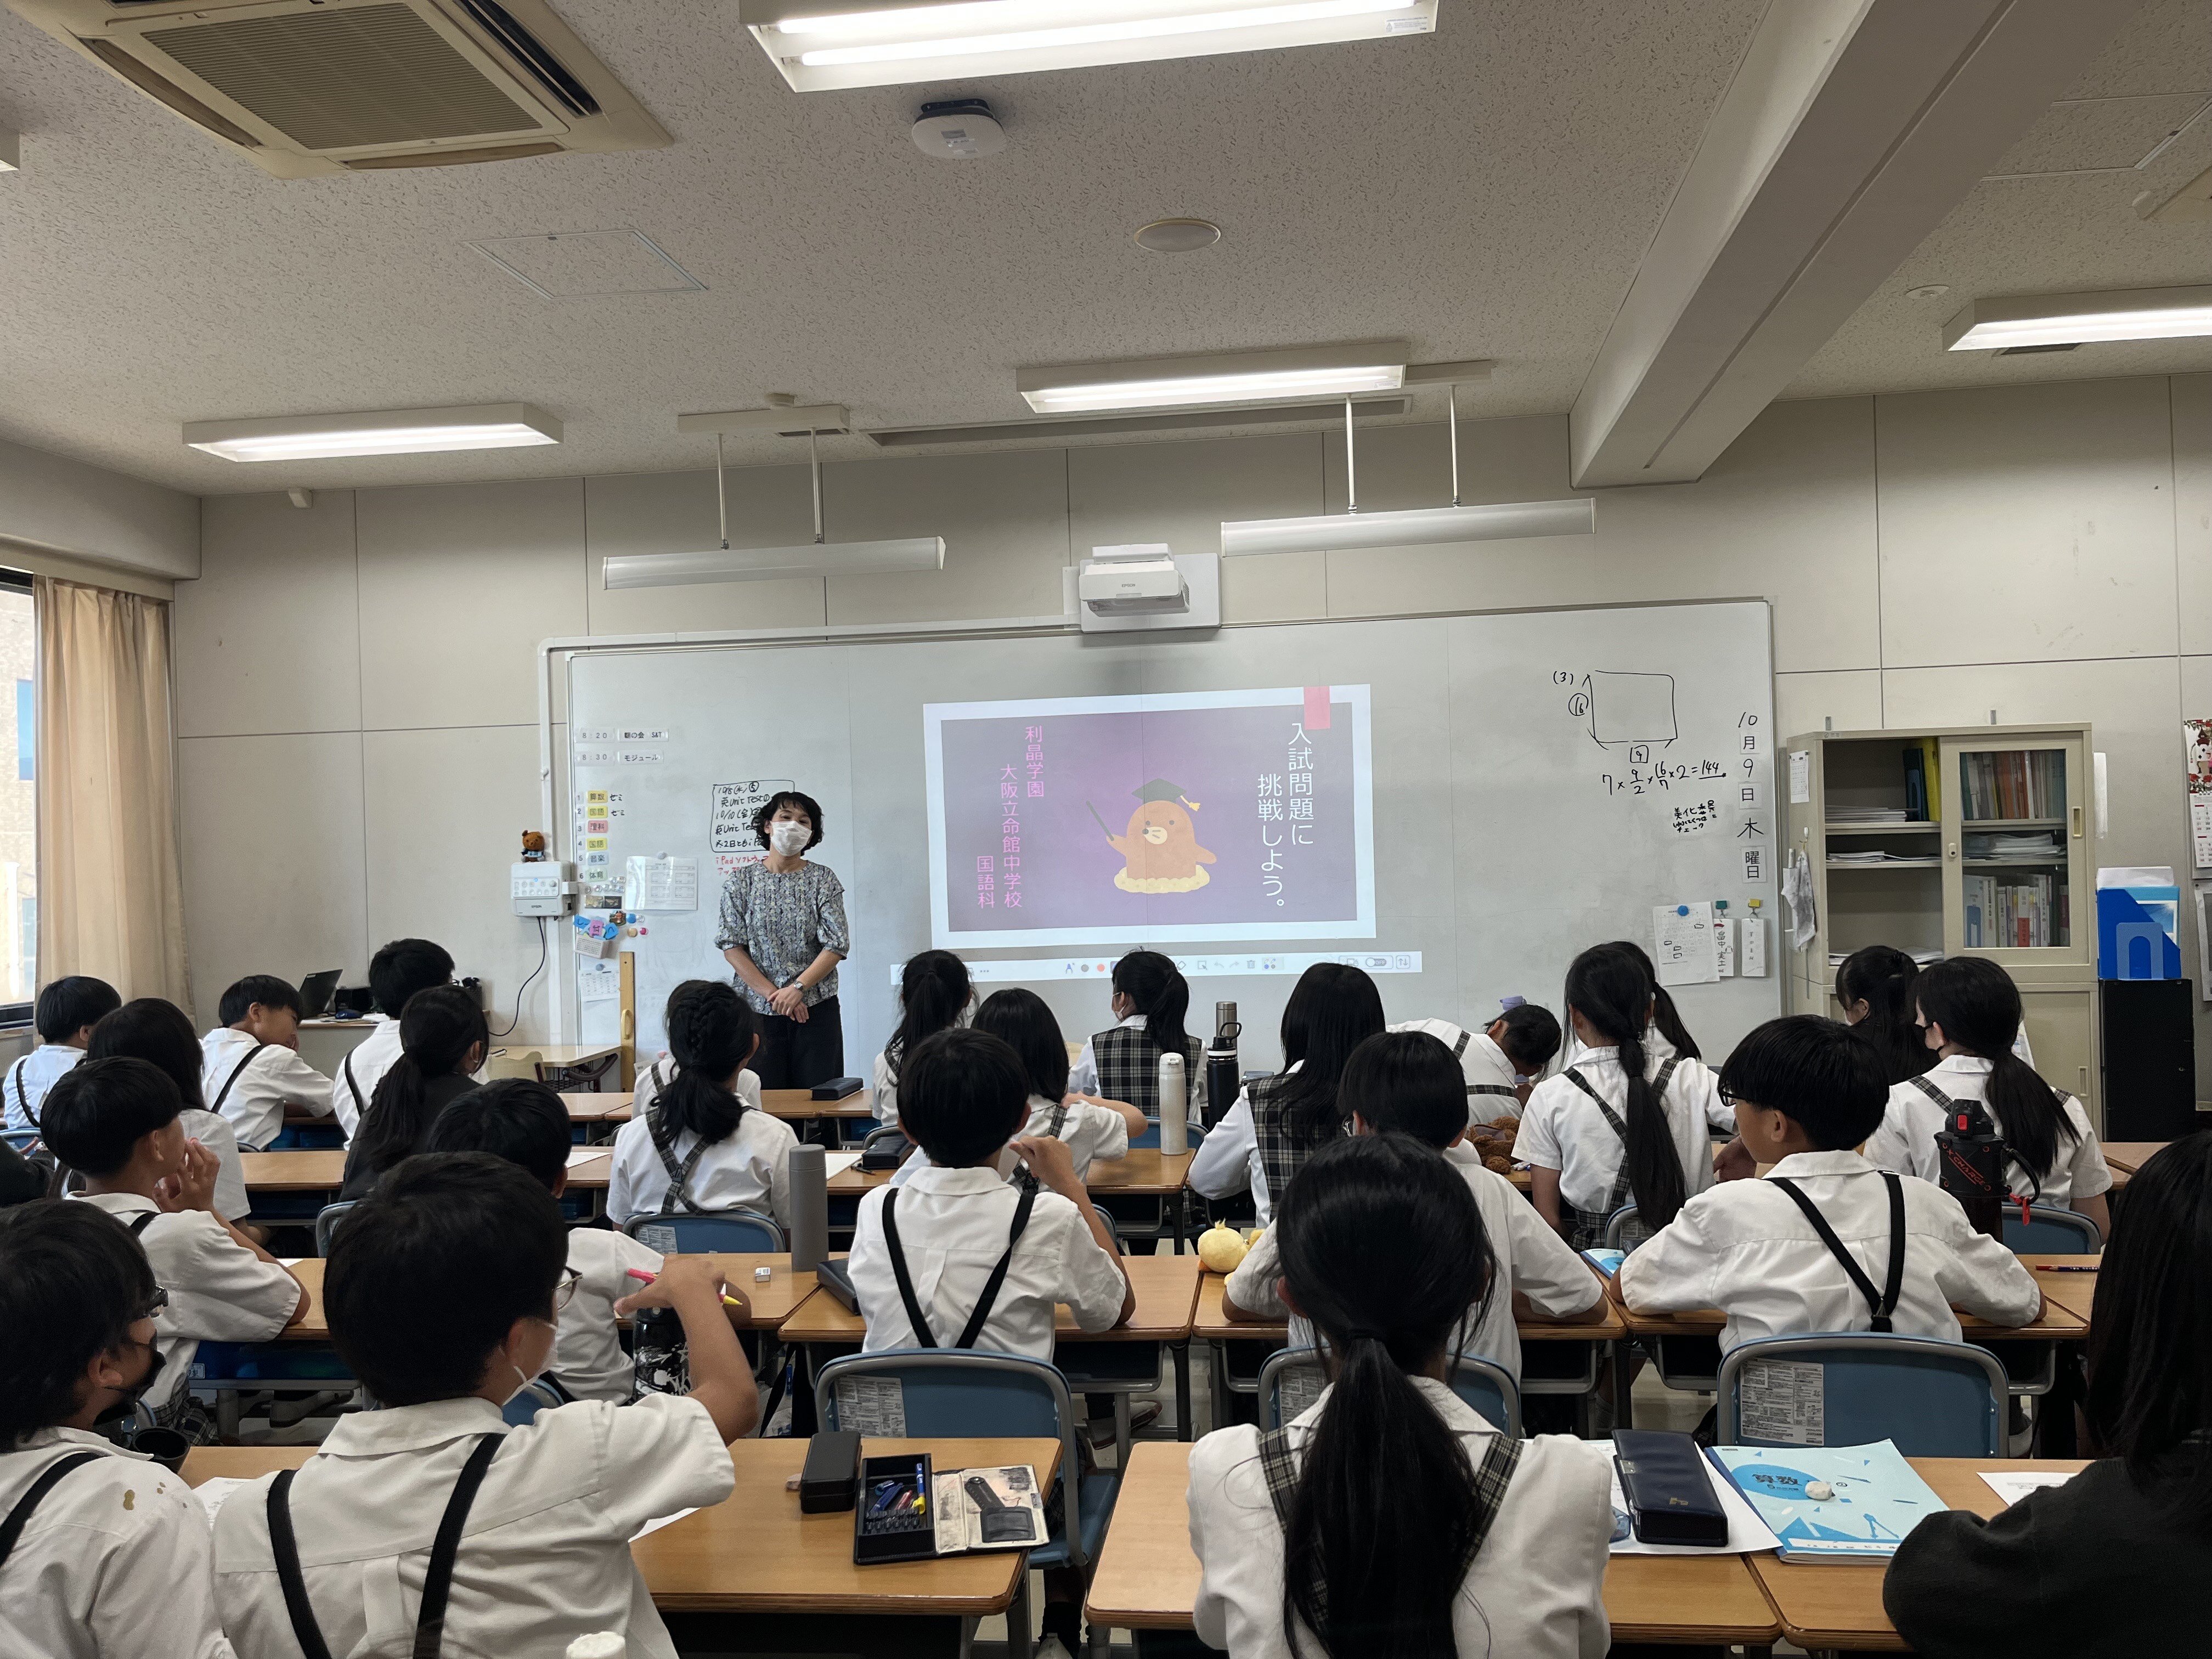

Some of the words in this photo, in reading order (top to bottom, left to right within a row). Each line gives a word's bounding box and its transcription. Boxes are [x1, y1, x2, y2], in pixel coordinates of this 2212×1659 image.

[1553, 670, 1573, 685] (3)
[1025, 725, 1045, 798] 利晶学園
[1288, 723, 1314, 845] 入試問題に
[977, 855, 995, 909] 国語科
[1000, 763, 1023, 909] 大阪立命館中学校
[1257, 773, 1285, 907] 挑戦しよう。
